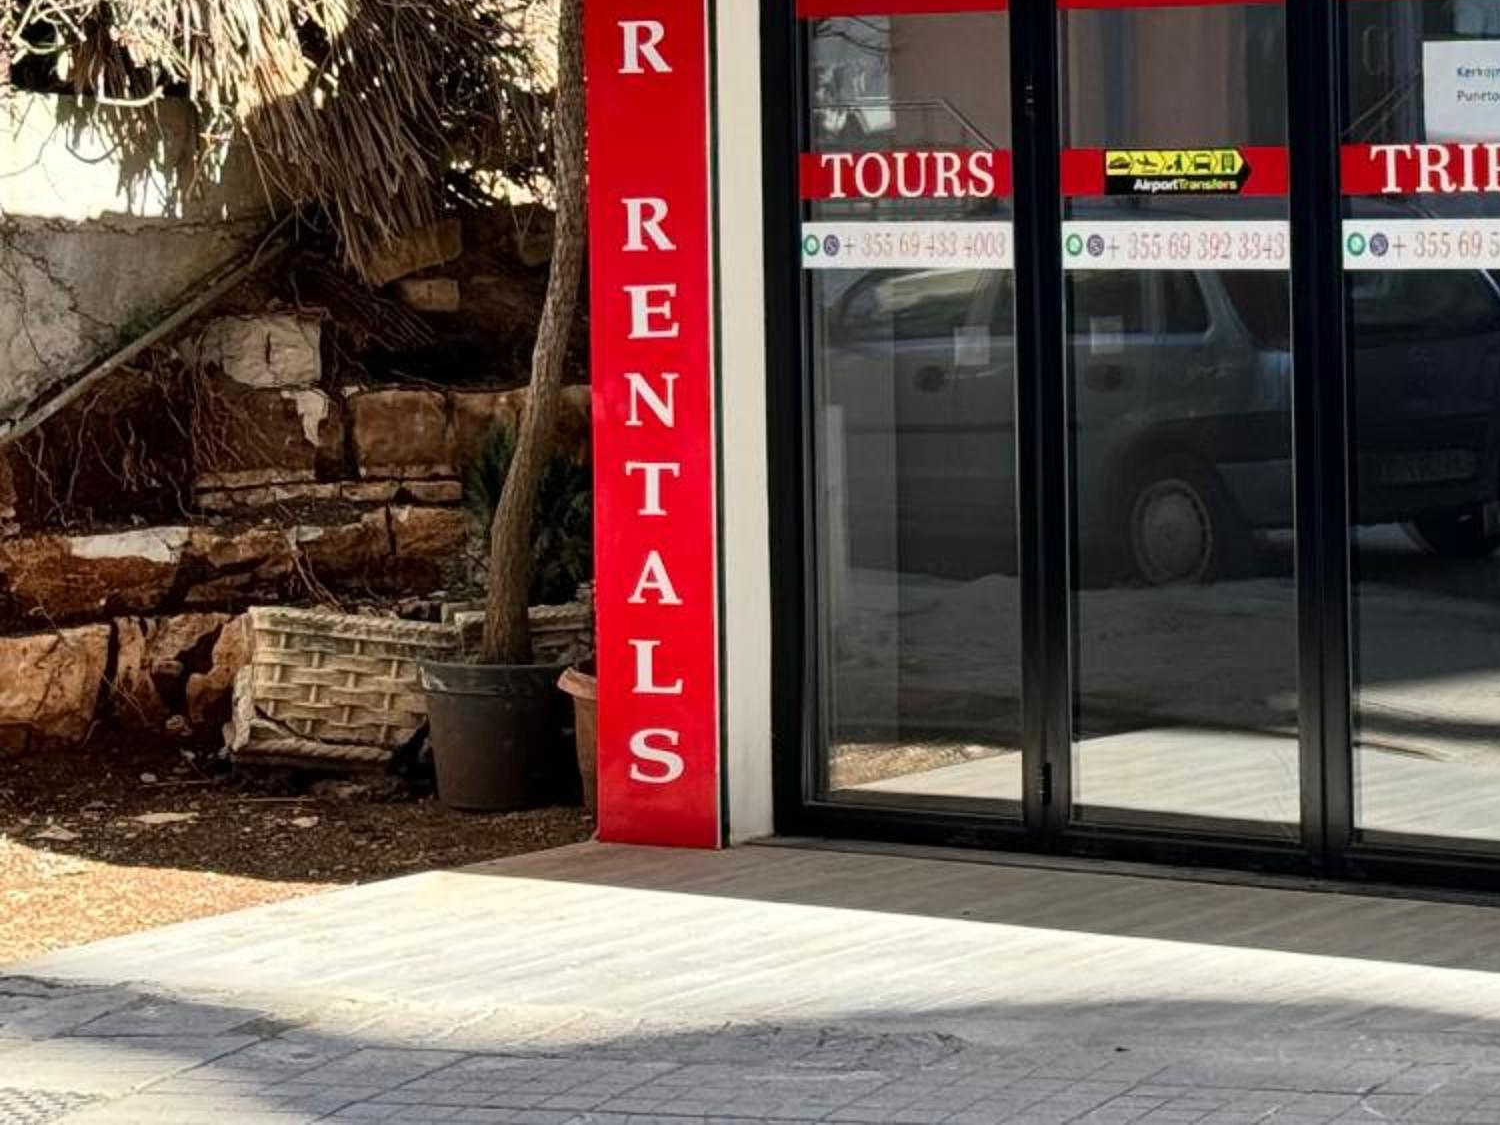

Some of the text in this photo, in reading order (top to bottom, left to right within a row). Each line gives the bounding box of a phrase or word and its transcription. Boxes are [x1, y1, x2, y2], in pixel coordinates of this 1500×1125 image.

[821, 150, 995, 199] TOURS
[863, 232, 893, 257] 355
[900, 232, 920, 257] 69
[1128, 232, 1161, 260] 355
[1168, 232, 1191, 260] 69
[1198, 232, 1232, 259] 392
[1237, 232, 1285, 260] 3343
[1414, 232, 1450, 258] 355
[1458, 232, 1482, 258] 69
[621, 197, 685, 784] RENTALS
